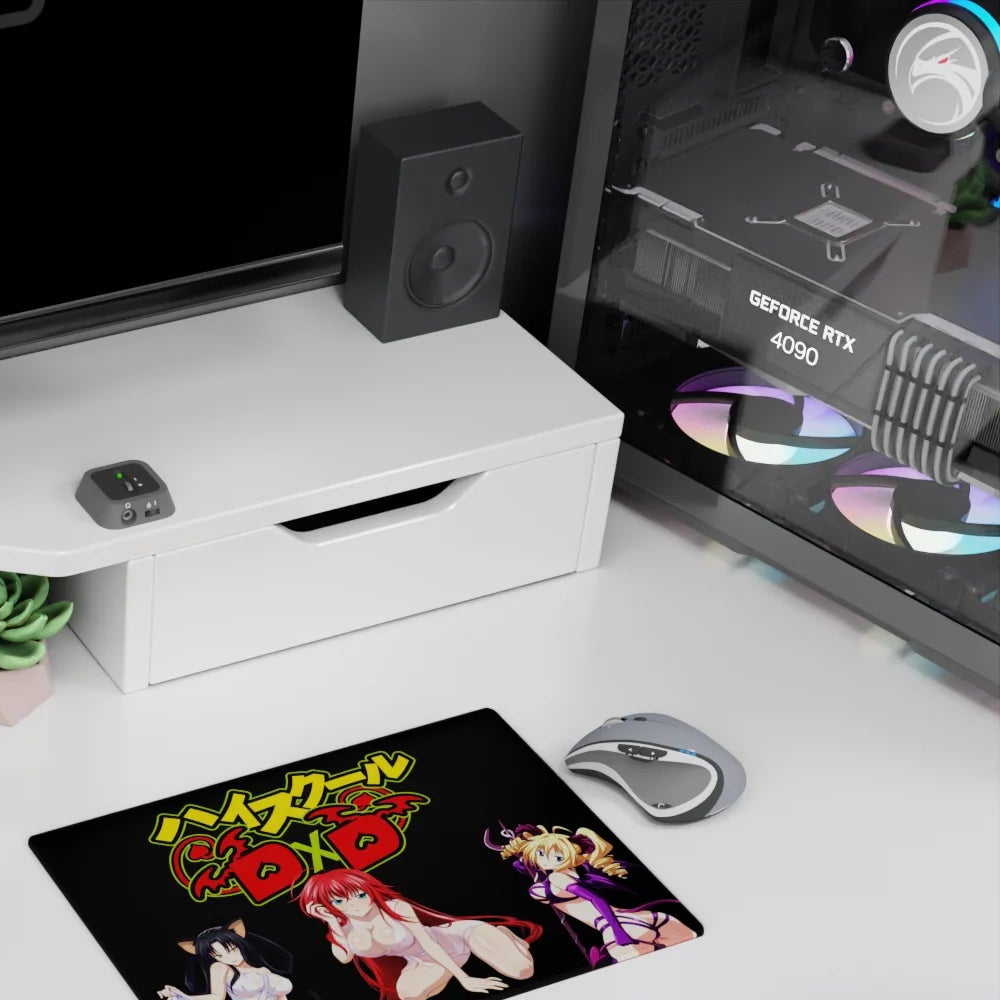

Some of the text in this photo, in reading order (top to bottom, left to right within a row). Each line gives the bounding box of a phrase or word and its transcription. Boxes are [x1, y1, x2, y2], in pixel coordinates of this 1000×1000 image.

[749, 289, 857, 354] GEFORCE RTX
[769, 331, 819, 367] 4090
[150, 752, 414, 844] ハイスクール
